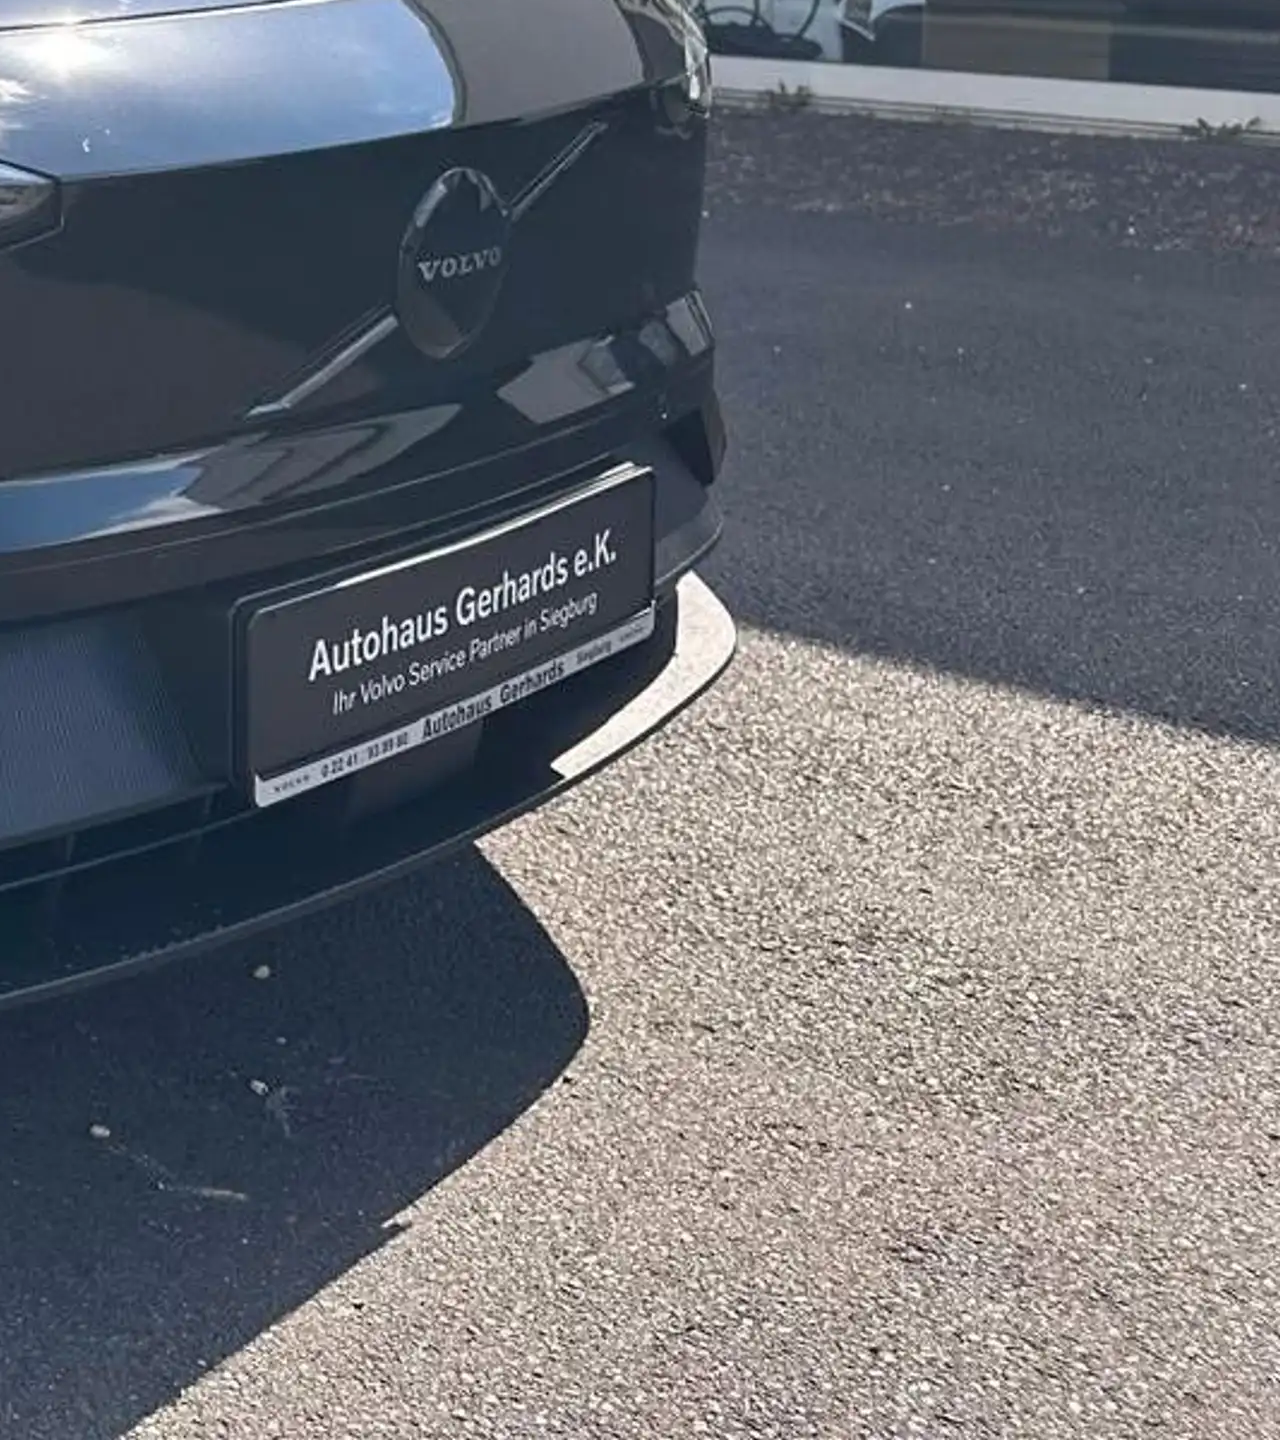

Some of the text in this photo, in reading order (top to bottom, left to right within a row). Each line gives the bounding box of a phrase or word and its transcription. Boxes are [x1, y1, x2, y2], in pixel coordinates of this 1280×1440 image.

[417, 245, 502, 282] VOLVO
[308, 528, 617, 682] Autohaus Gerhards e.K.
[333, 591, 598, 716] Ihr Volvo Service Partner in Siegburg
[422, 692, 493, 739] Autohaus
[498, 659, 565, 706] Gerhards
